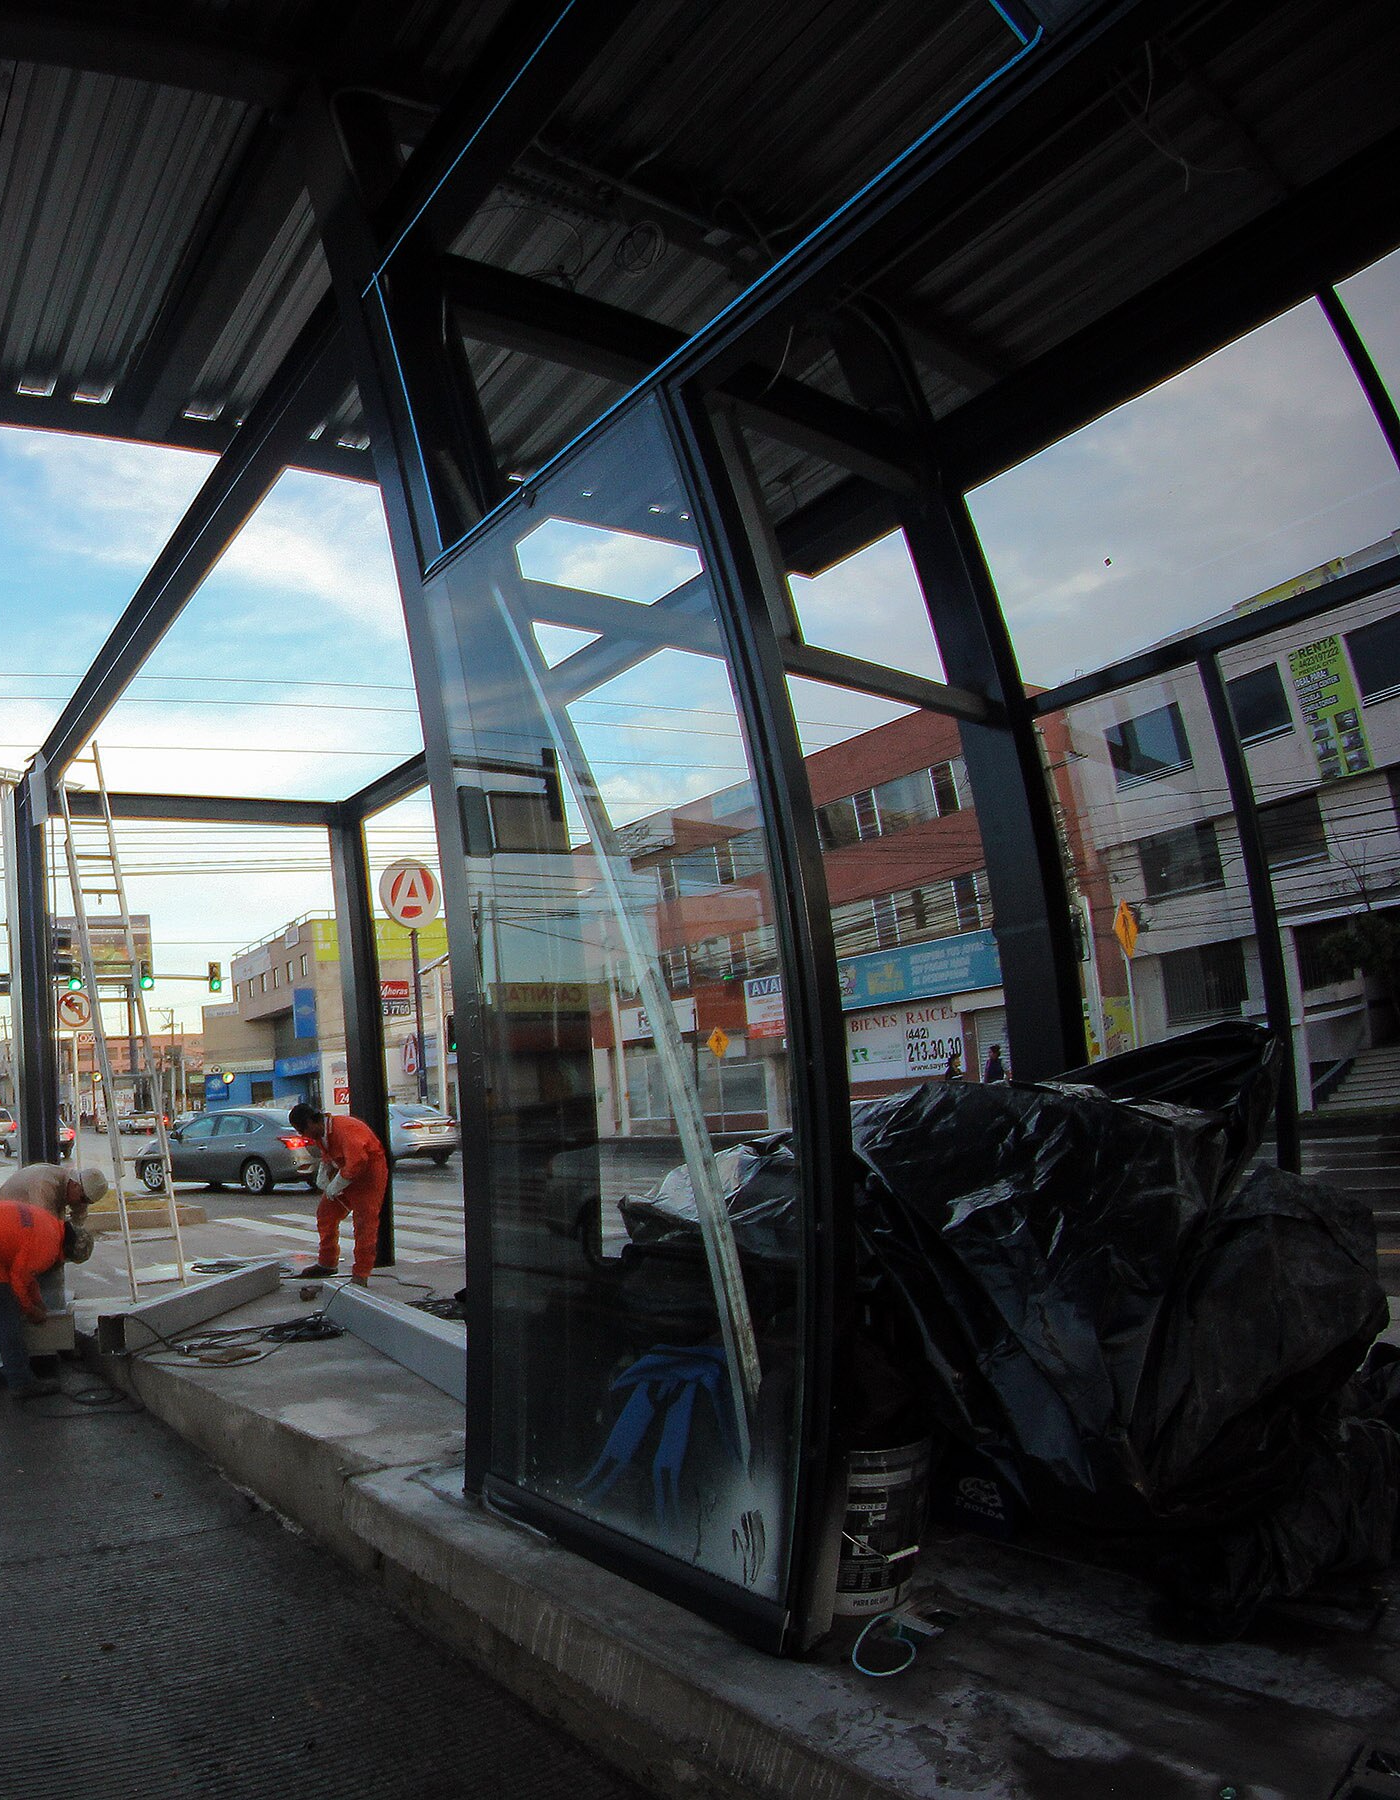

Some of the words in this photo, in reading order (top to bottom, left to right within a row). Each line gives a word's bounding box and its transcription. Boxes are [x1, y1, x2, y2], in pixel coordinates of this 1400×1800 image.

[1297, 636, 1336, 659] RENTA
[850, 1013, 898, 1033] BIENES
[905, 1006, 958, 1025] RAICES
[905, 1028, 930, 1042] (442)
[906, 1036, 962, 1063] 213.30.30
